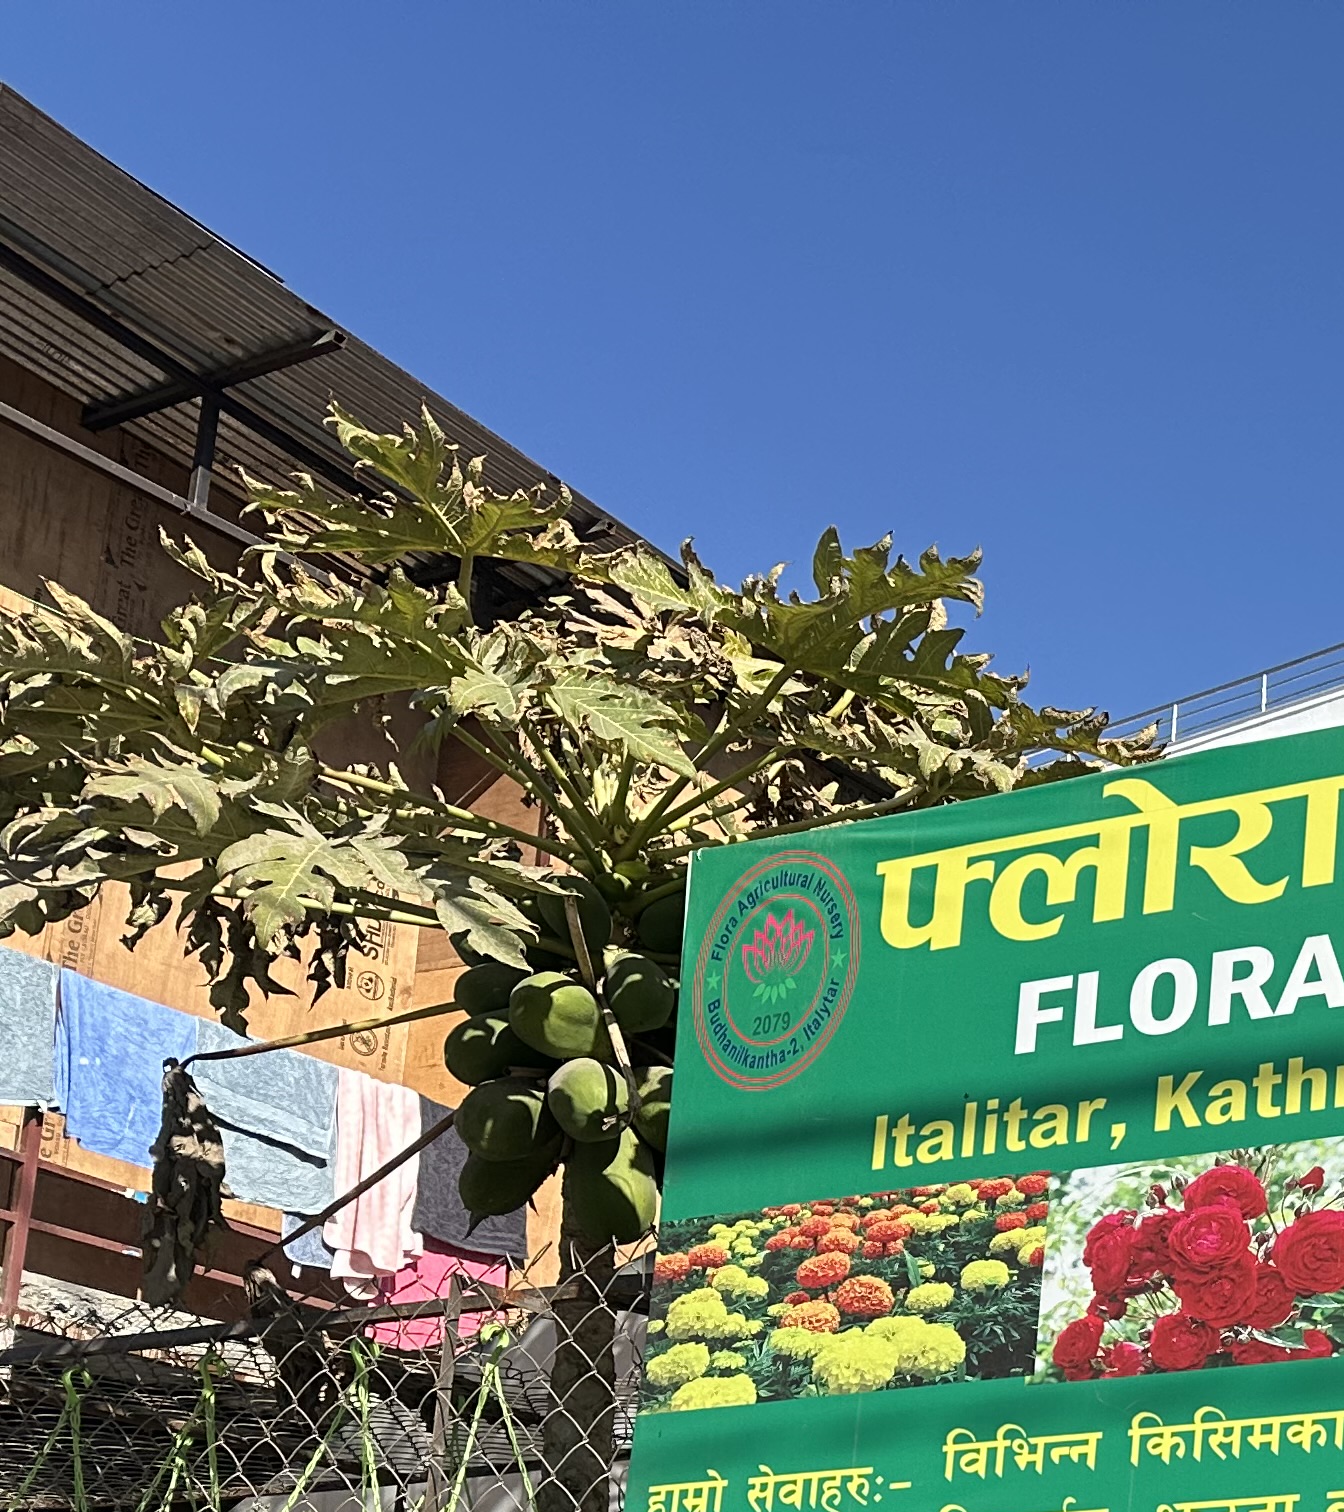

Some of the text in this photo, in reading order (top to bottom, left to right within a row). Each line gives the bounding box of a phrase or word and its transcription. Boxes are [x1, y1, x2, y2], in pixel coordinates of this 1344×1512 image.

[711, 869, 845, 962] Flora Agricultural Nursery
[707, 977, 841, 1070] Budhanilkantha-2, Italytar
[752, 1010, 791, 1037] 2079
[872, 1094, 1126, 1171] Italitar,
[942, 1422, 1103, 1483] विभिन्न
